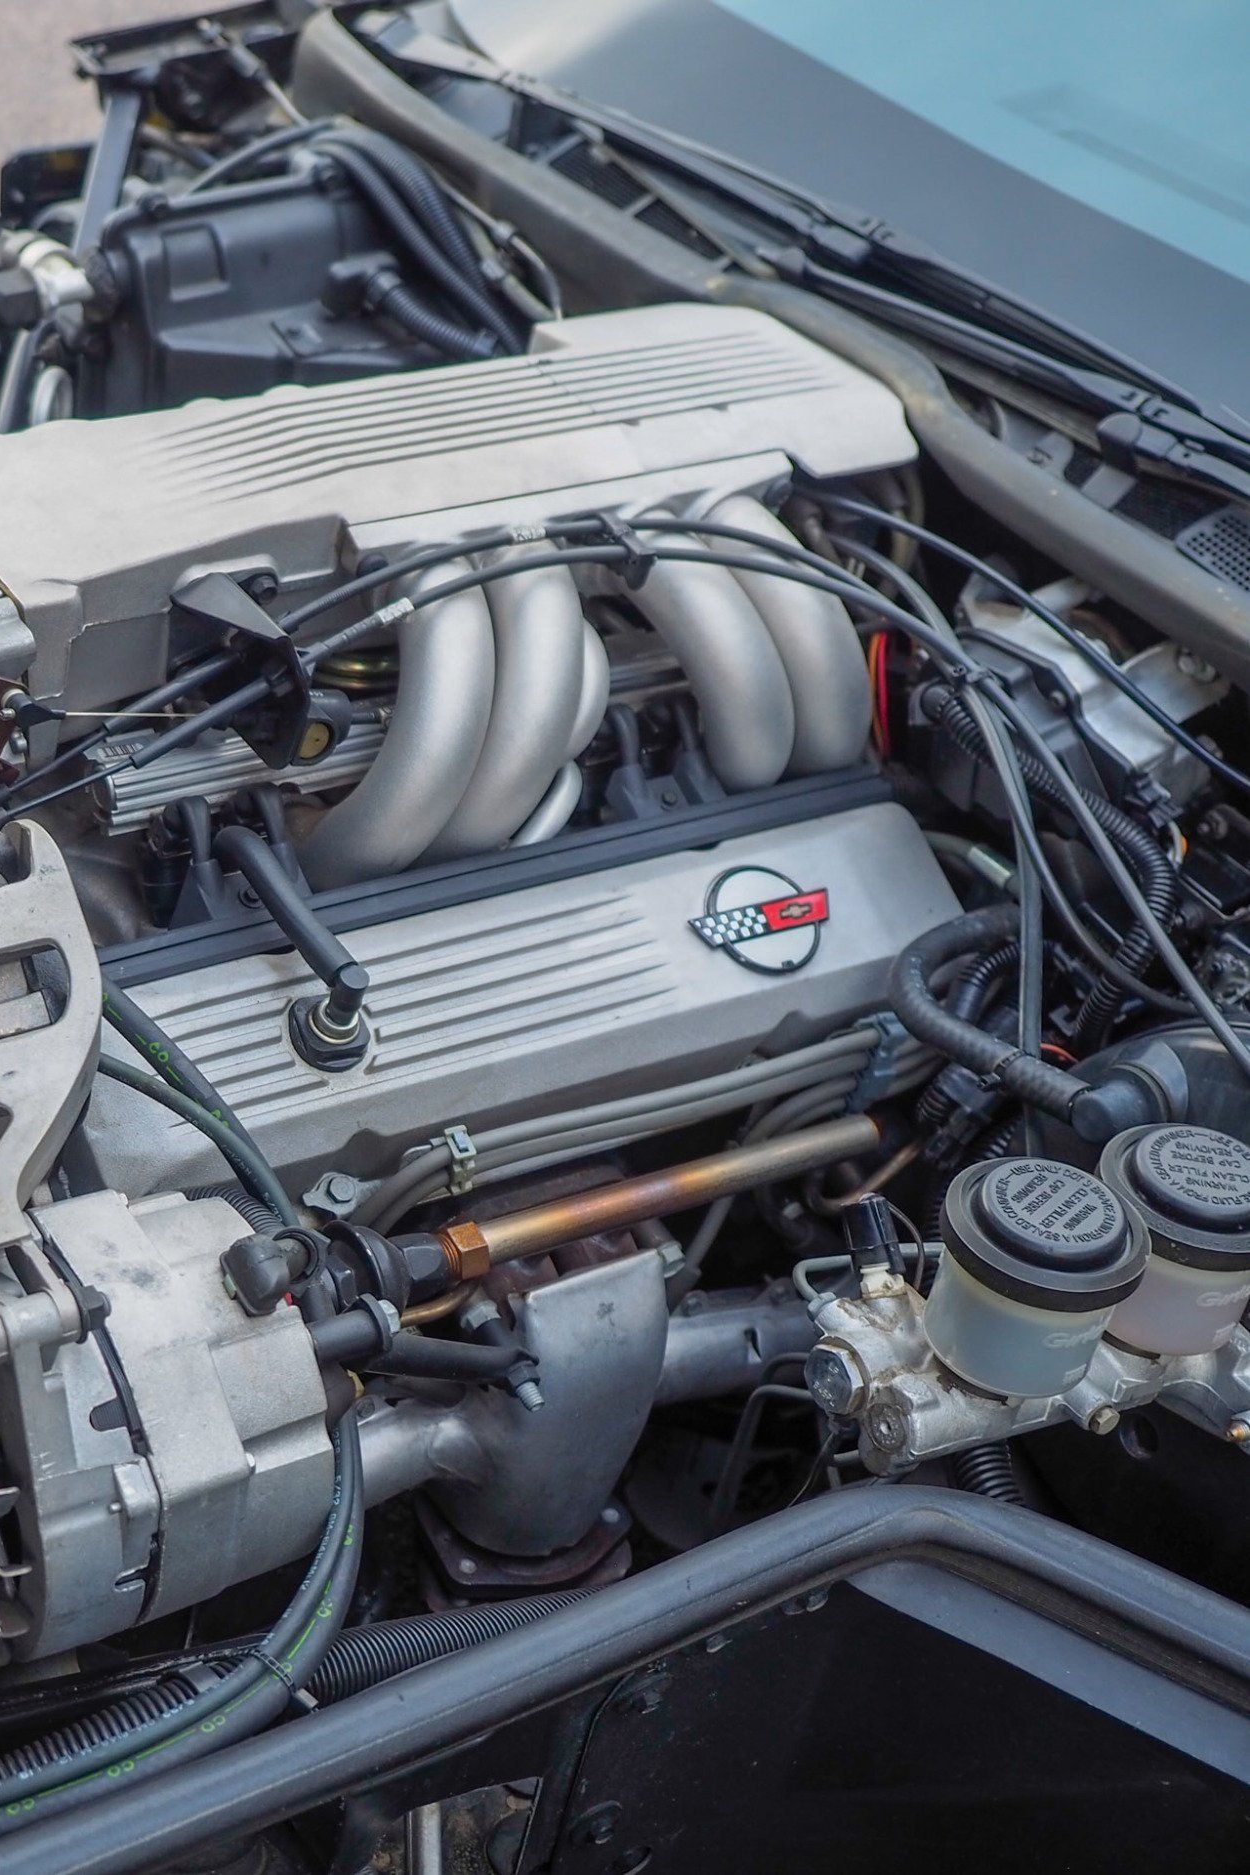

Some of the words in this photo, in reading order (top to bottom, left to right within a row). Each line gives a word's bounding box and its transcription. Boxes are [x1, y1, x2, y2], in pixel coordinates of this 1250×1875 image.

[1175, 1141, 1233, 1158] REMOVING
[1170, 1150, 1214, 1165] BEFORE
[1219, 1159, 1241, 1168] CAP
[1168, 1163, 1208, 1177] FILLER
[1212, 1171, 1250, 1184] CLEAN
[1185, 1177, 1239, 1192] WARNING
[1062, 1188, 1089, 1210] CLEAN
[1038, 1205, 1069, 1229] FILLER
